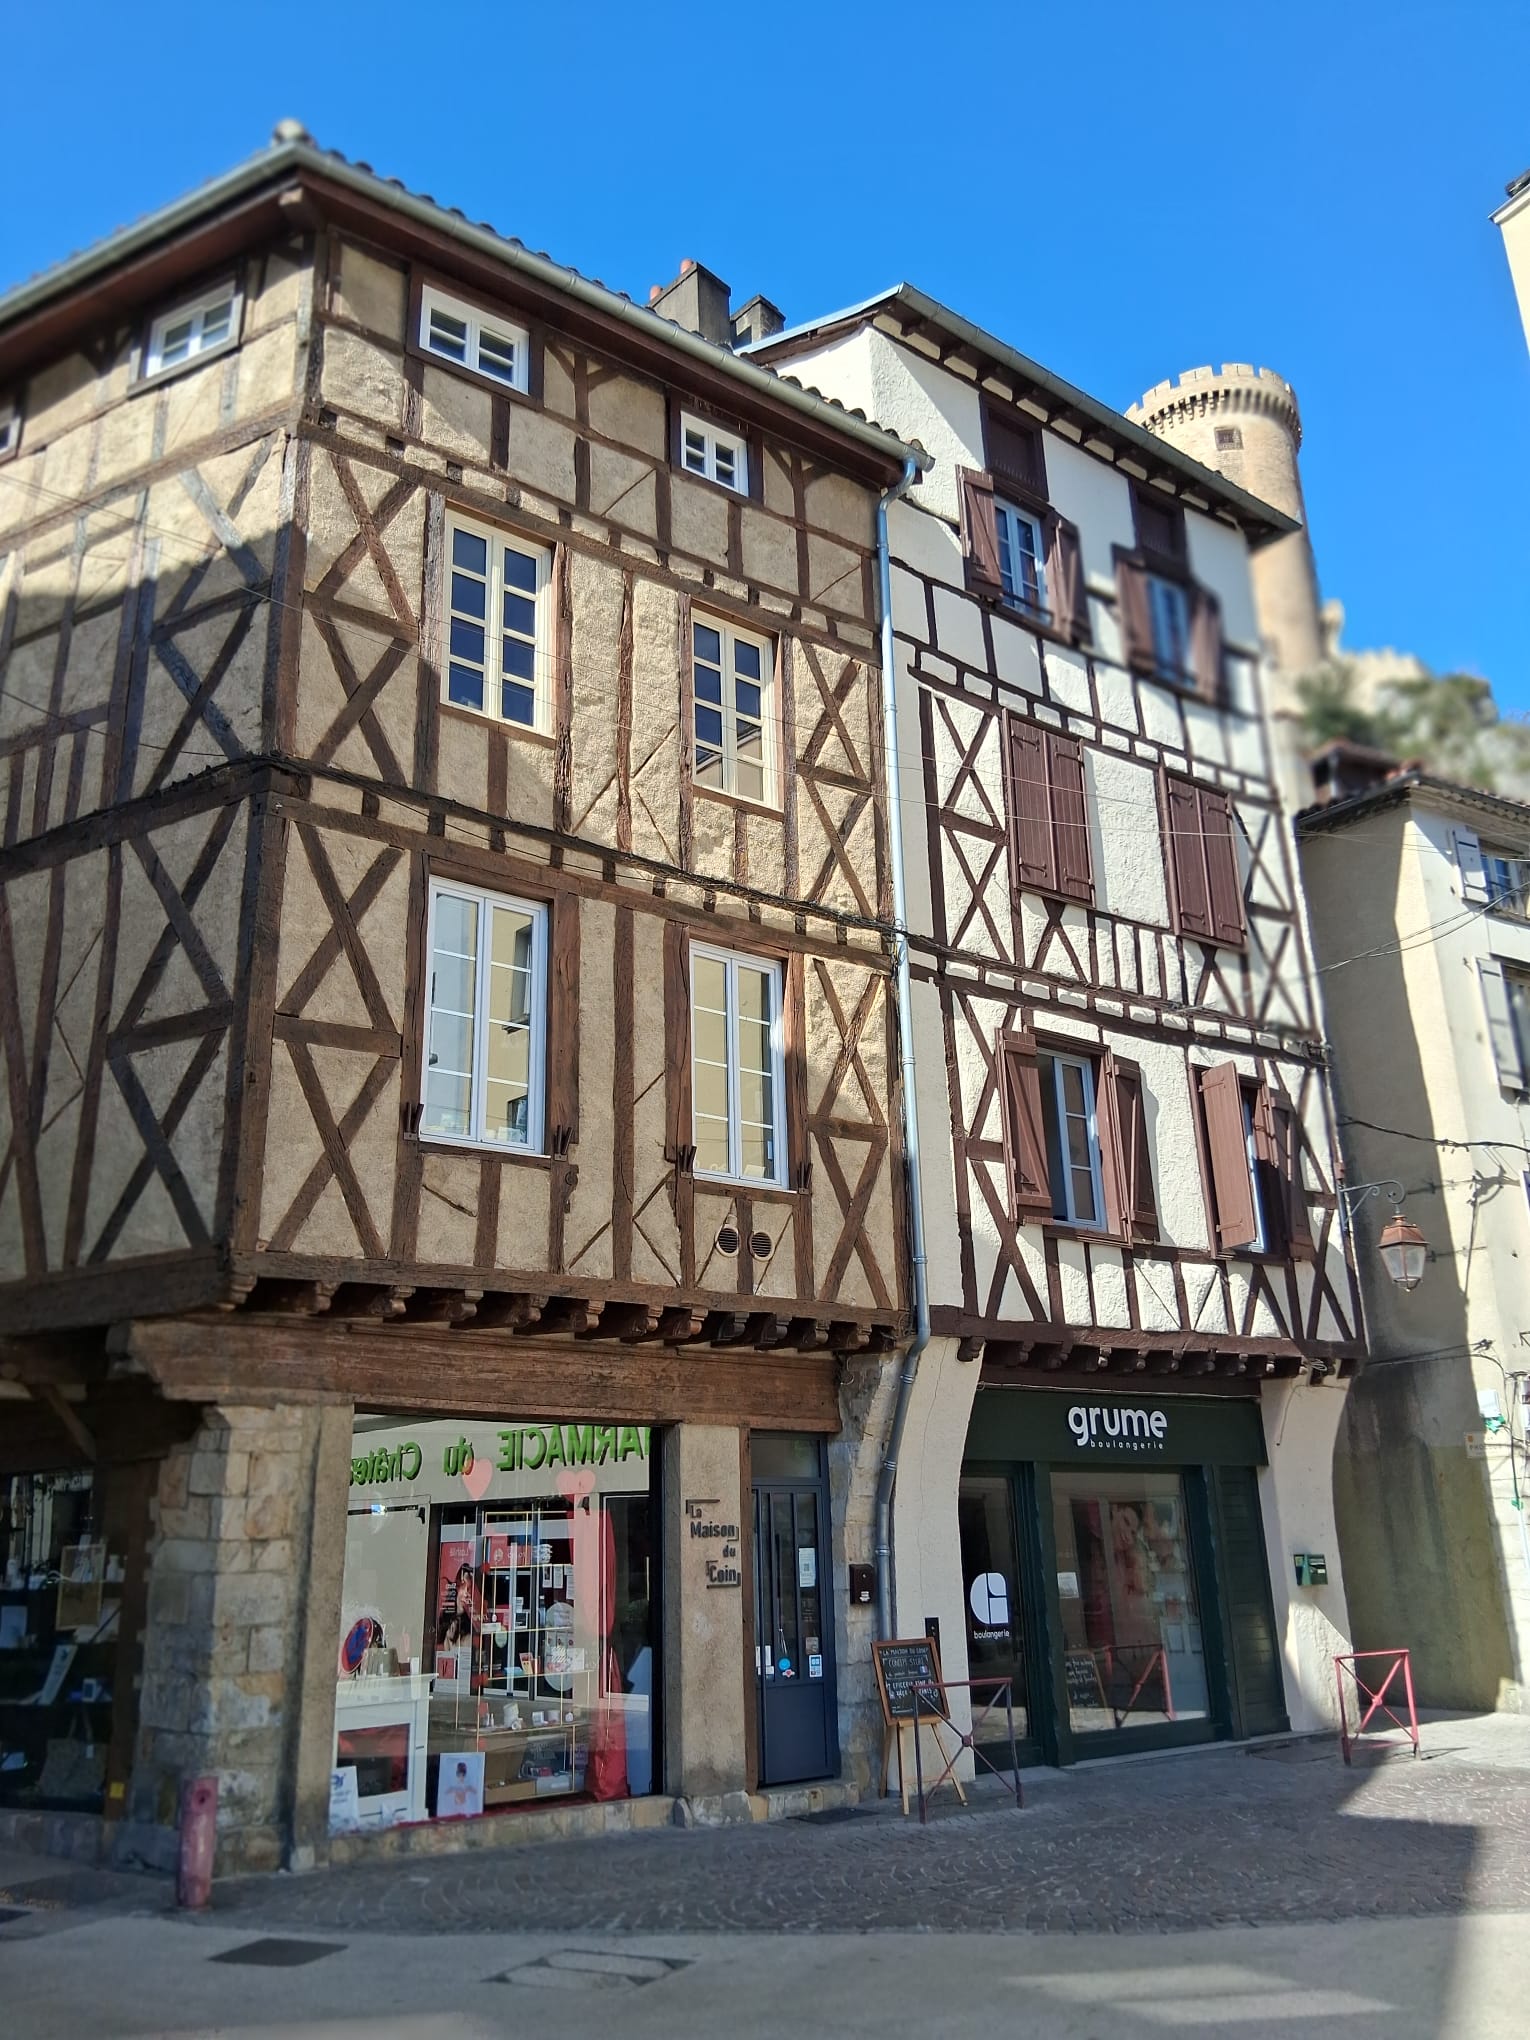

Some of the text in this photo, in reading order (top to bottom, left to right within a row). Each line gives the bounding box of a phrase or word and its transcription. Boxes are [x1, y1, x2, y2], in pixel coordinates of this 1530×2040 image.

[1068, 1407, 1168, 1446] grume
[1090, 1439, 1164, 1451] boulangerie
[691, 1505, 702, 1518] La
[690, 1521, 735, 1538] Maison
[723, 1545, 736, 1558] du
[709, 1565, 737, 1583] Coin
[973, 1628, 1010, 1640] boulangerie
